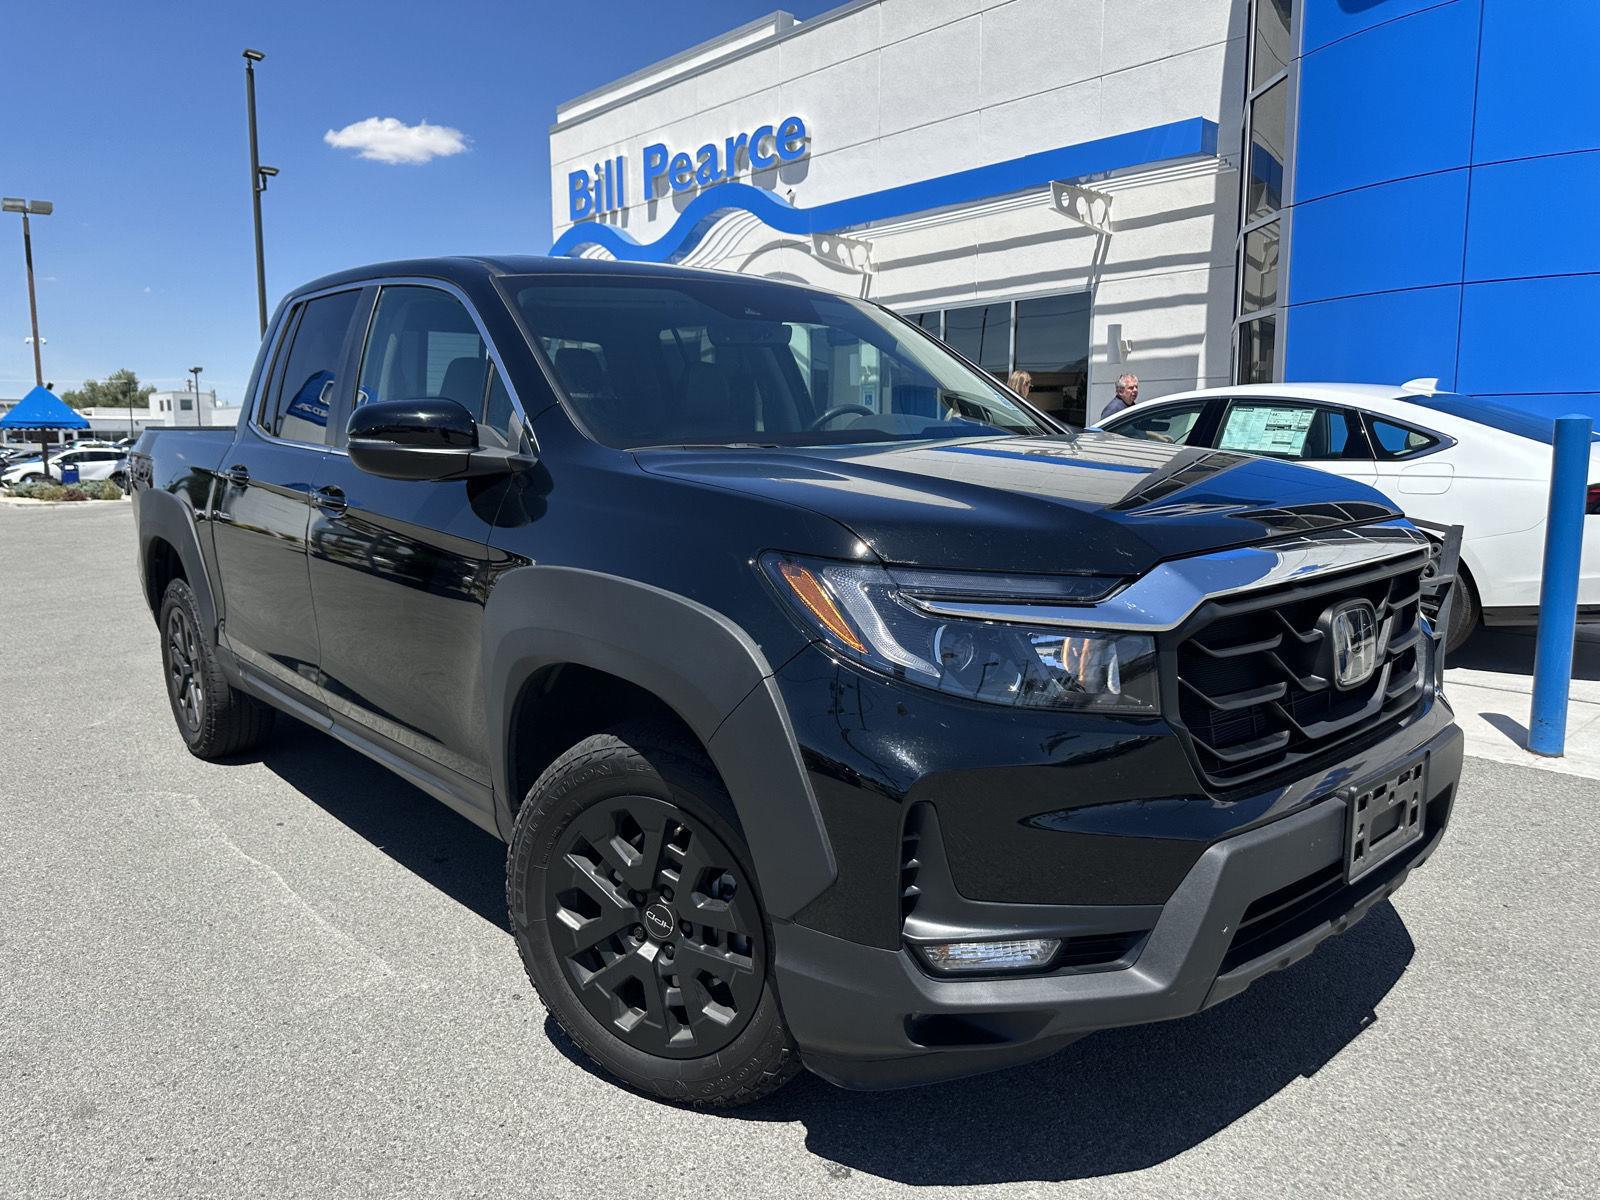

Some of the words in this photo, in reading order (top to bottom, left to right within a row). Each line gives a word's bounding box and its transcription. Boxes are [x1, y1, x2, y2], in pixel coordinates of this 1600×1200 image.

[568, 155, 624, 221] Bill
[643, 116, 806, 201] Pearce
[646, 910, 673, 931] HPD
